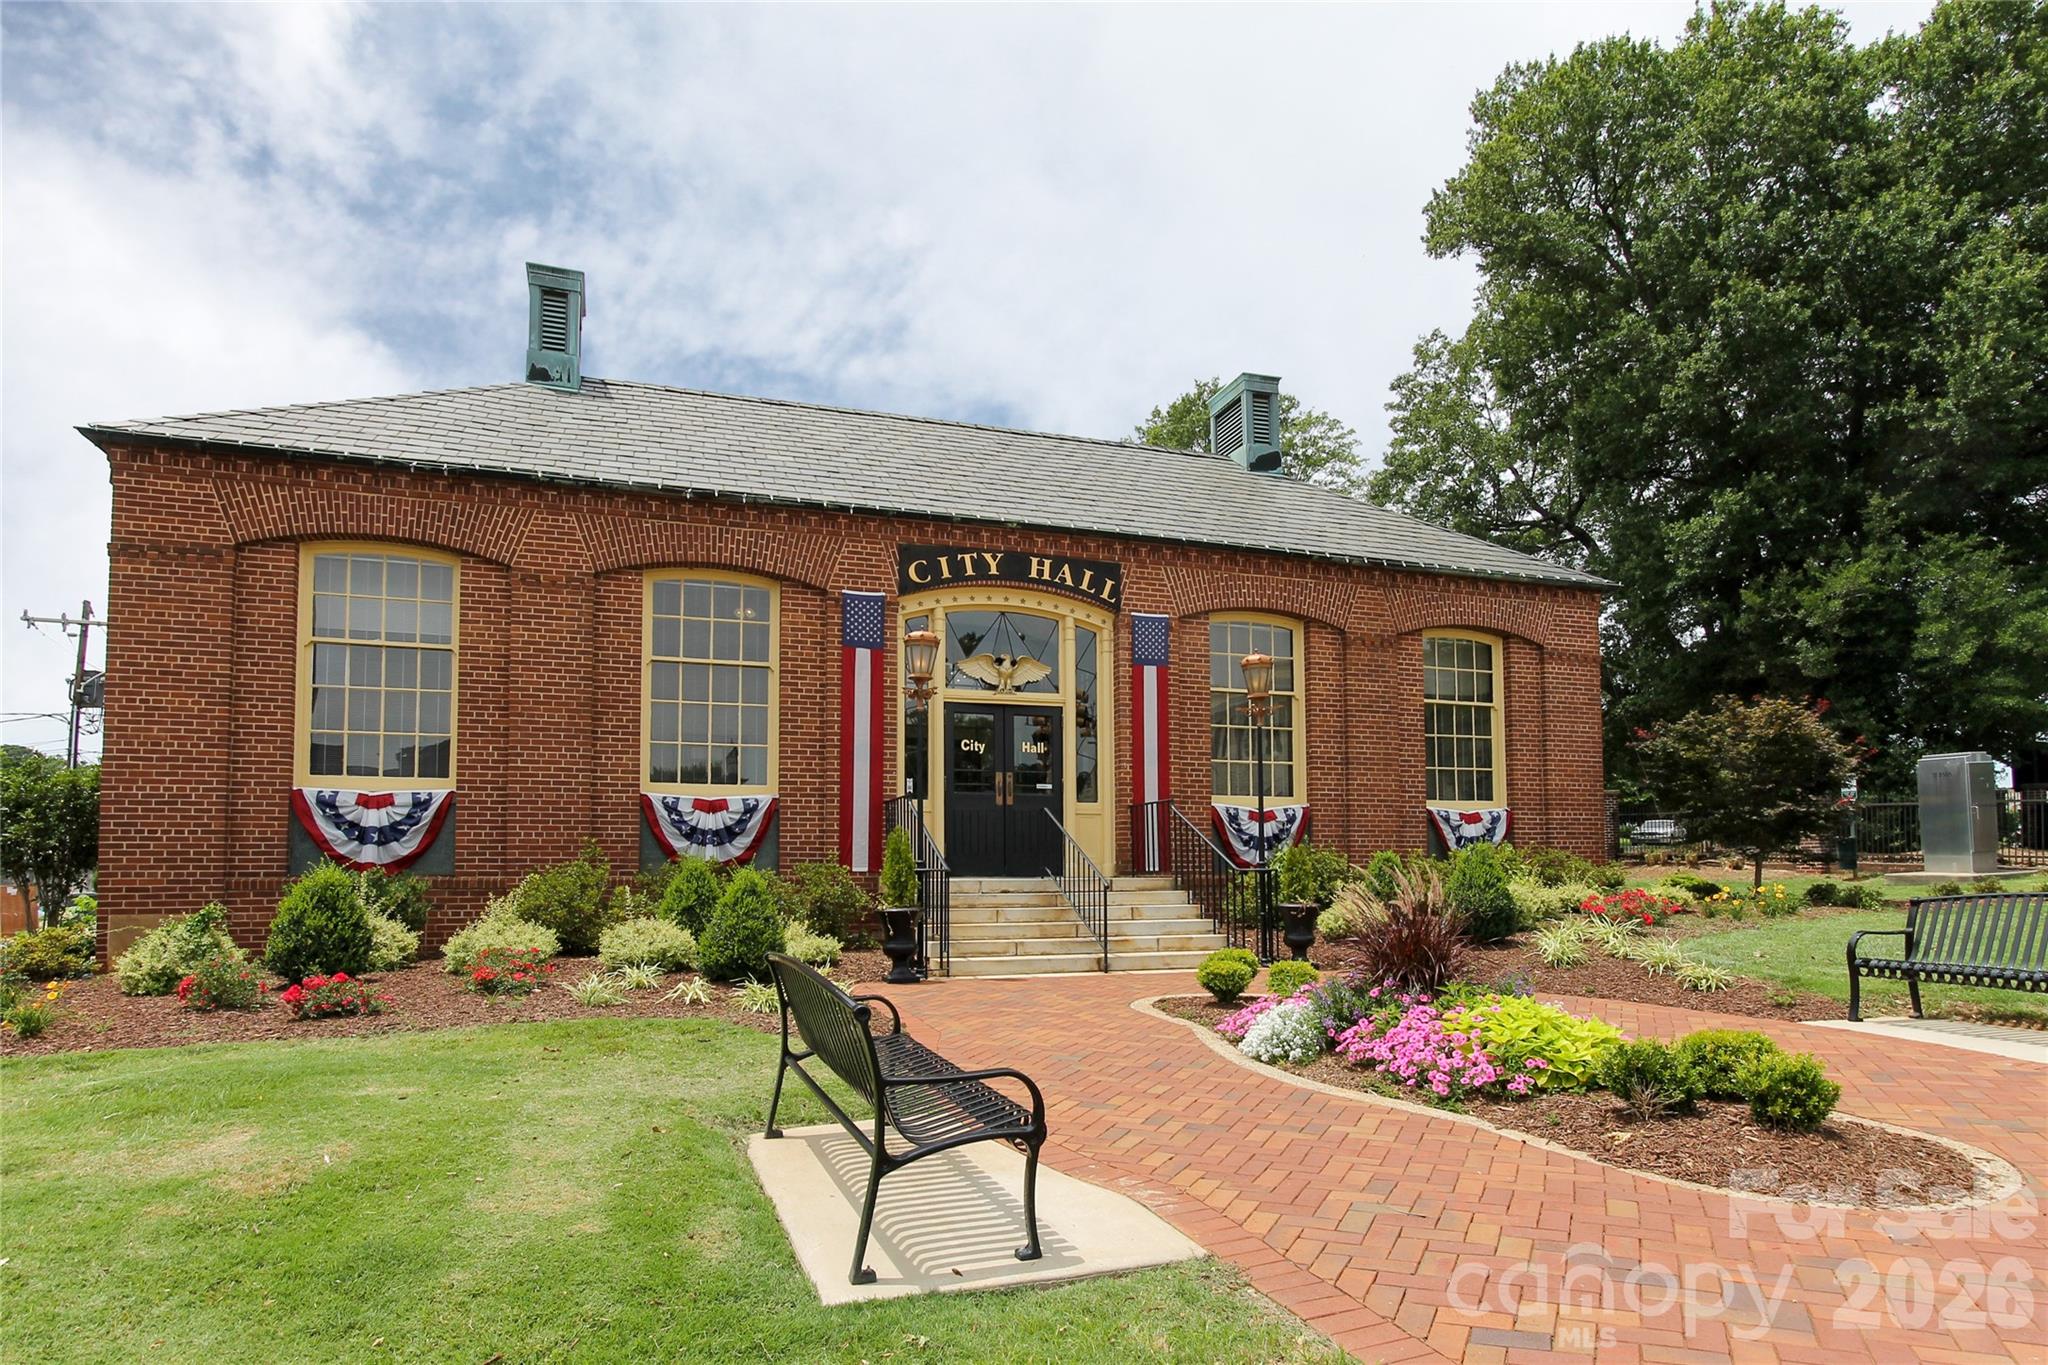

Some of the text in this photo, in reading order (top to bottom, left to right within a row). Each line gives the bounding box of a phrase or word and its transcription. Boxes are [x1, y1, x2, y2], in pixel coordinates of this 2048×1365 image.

[907, 552, 1116, 603] CITY HALL
[960, 739, 1045, 754] City Hall
